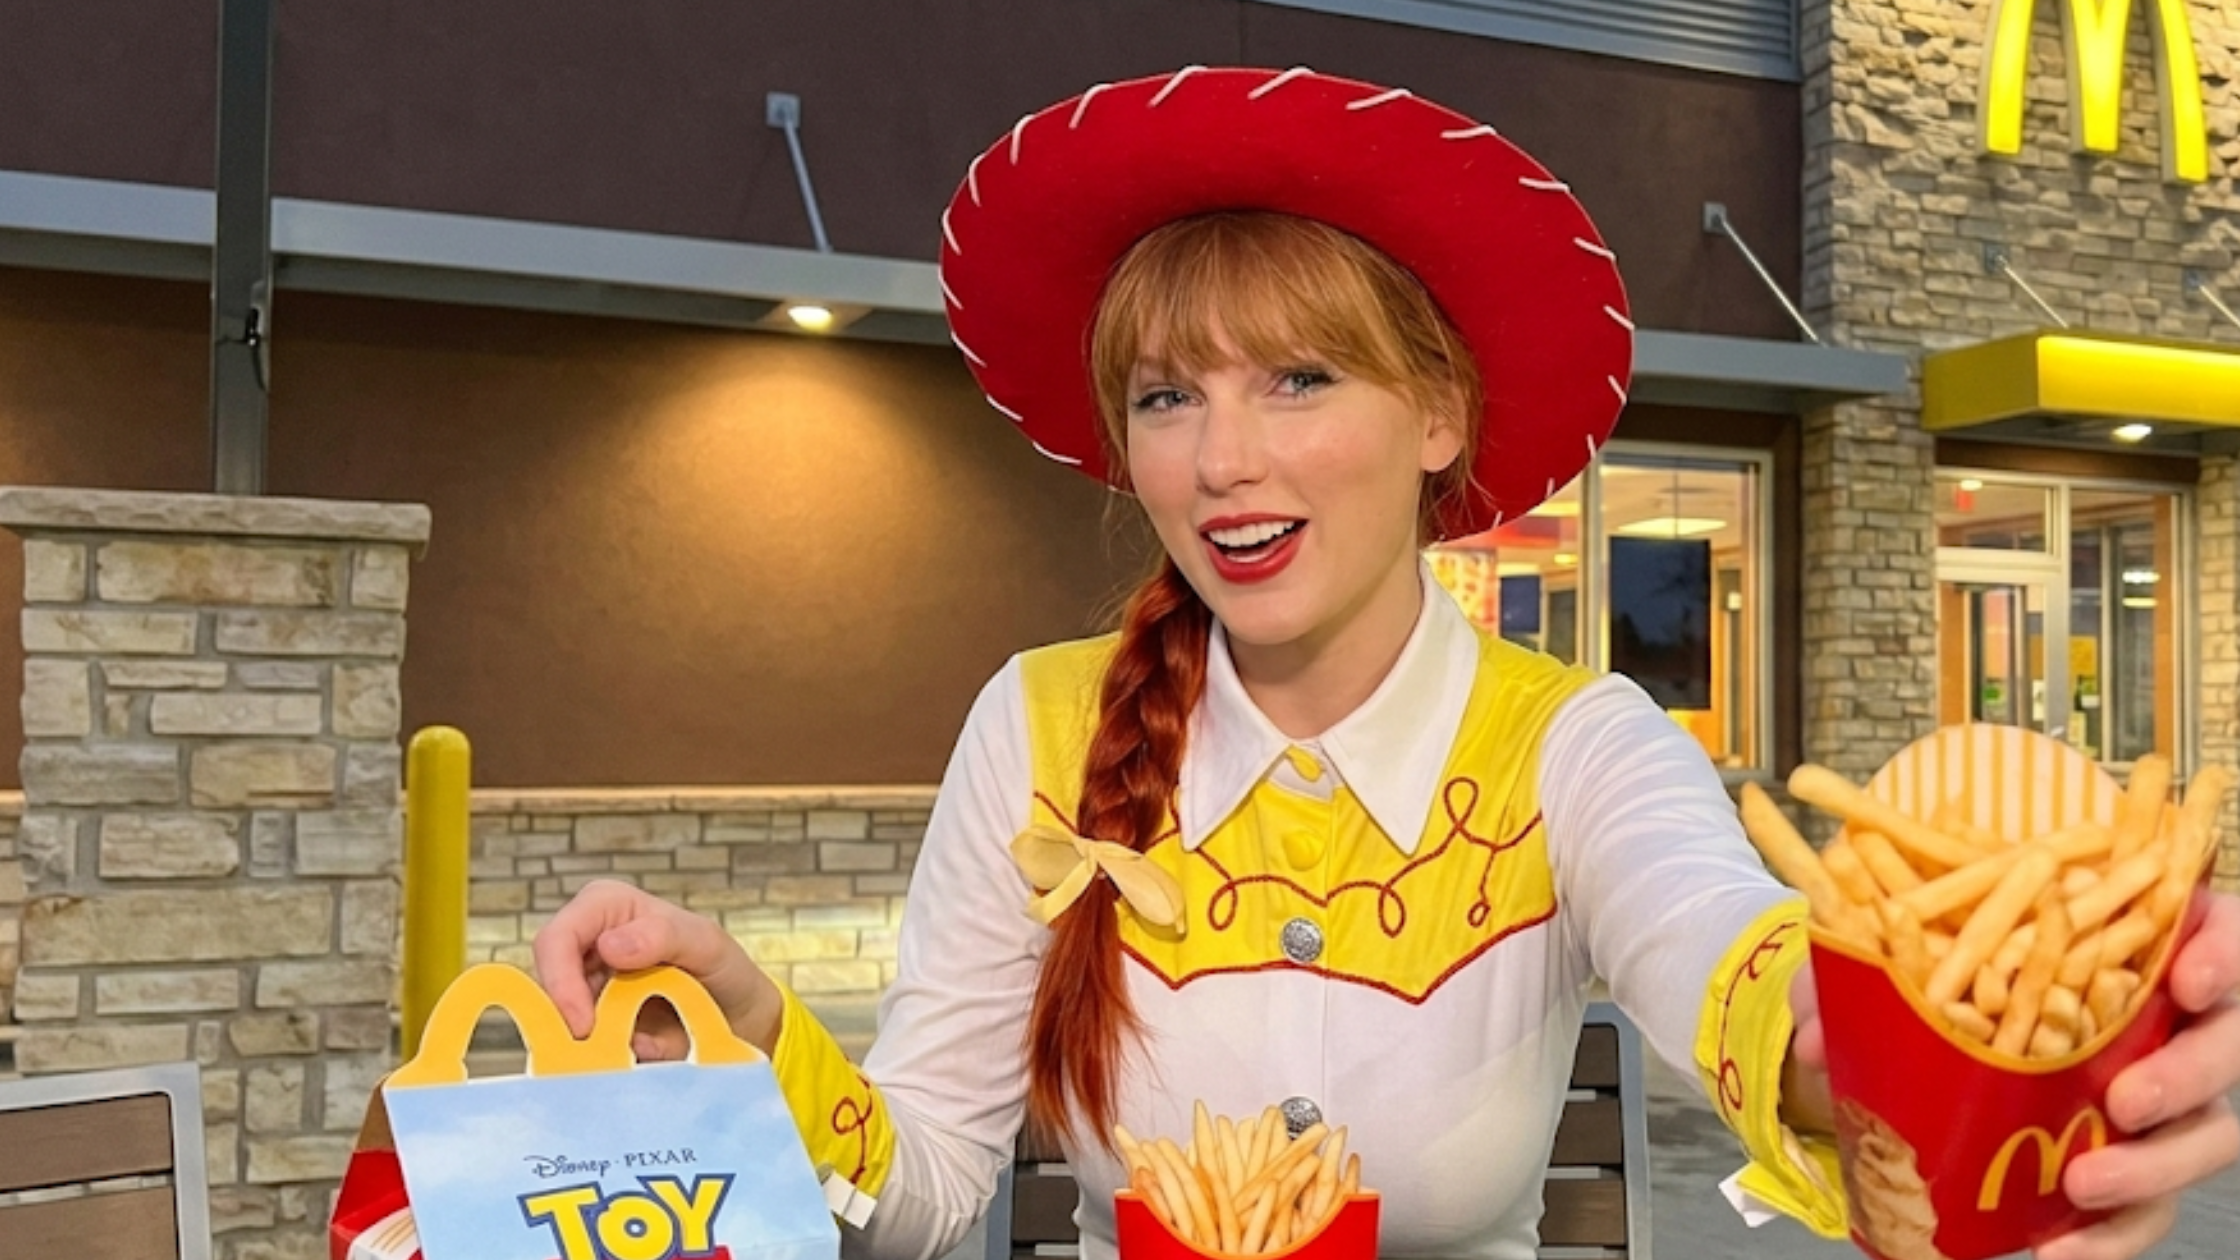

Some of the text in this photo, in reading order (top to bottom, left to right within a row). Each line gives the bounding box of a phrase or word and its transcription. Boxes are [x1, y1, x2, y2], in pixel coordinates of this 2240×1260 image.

[523, 1147, 698, 1179] Disney PIXAR
[516, 1173, 737, 1260] TOY
